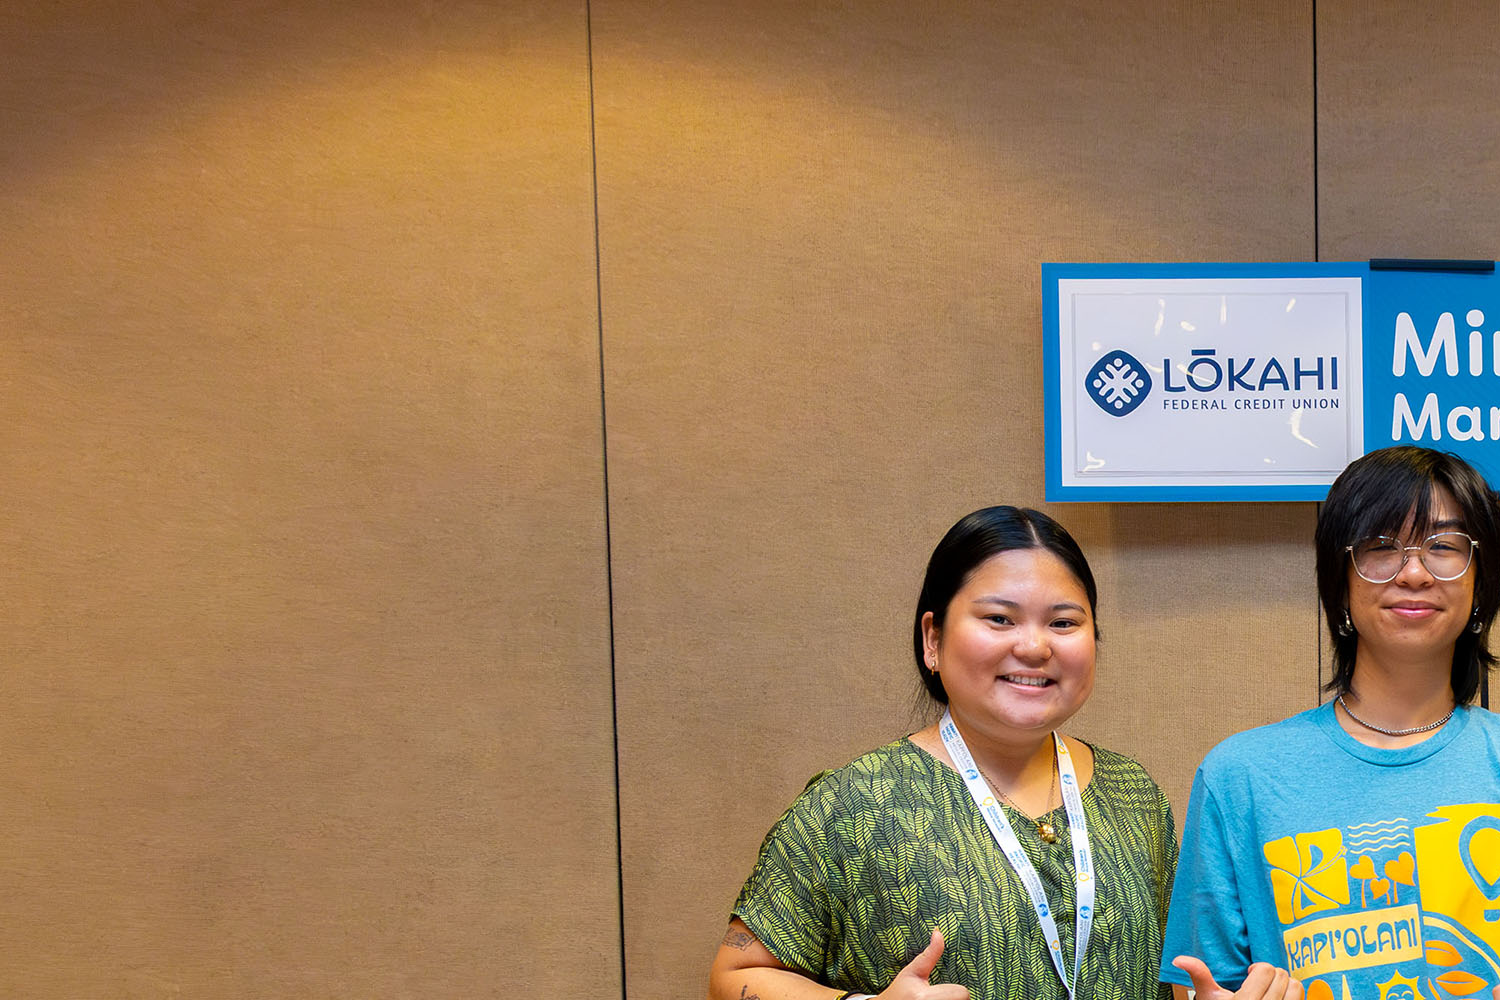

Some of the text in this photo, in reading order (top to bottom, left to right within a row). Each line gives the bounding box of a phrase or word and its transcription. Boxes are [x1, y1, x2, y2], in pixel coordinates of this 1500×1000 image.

[1164, 349, 1337, 392] LŌKAHI
[1163, 398, 1339, 410] FEDERAL CREDIT UNION
[1288, 918, 1418, 971] KAPI'OLANI
